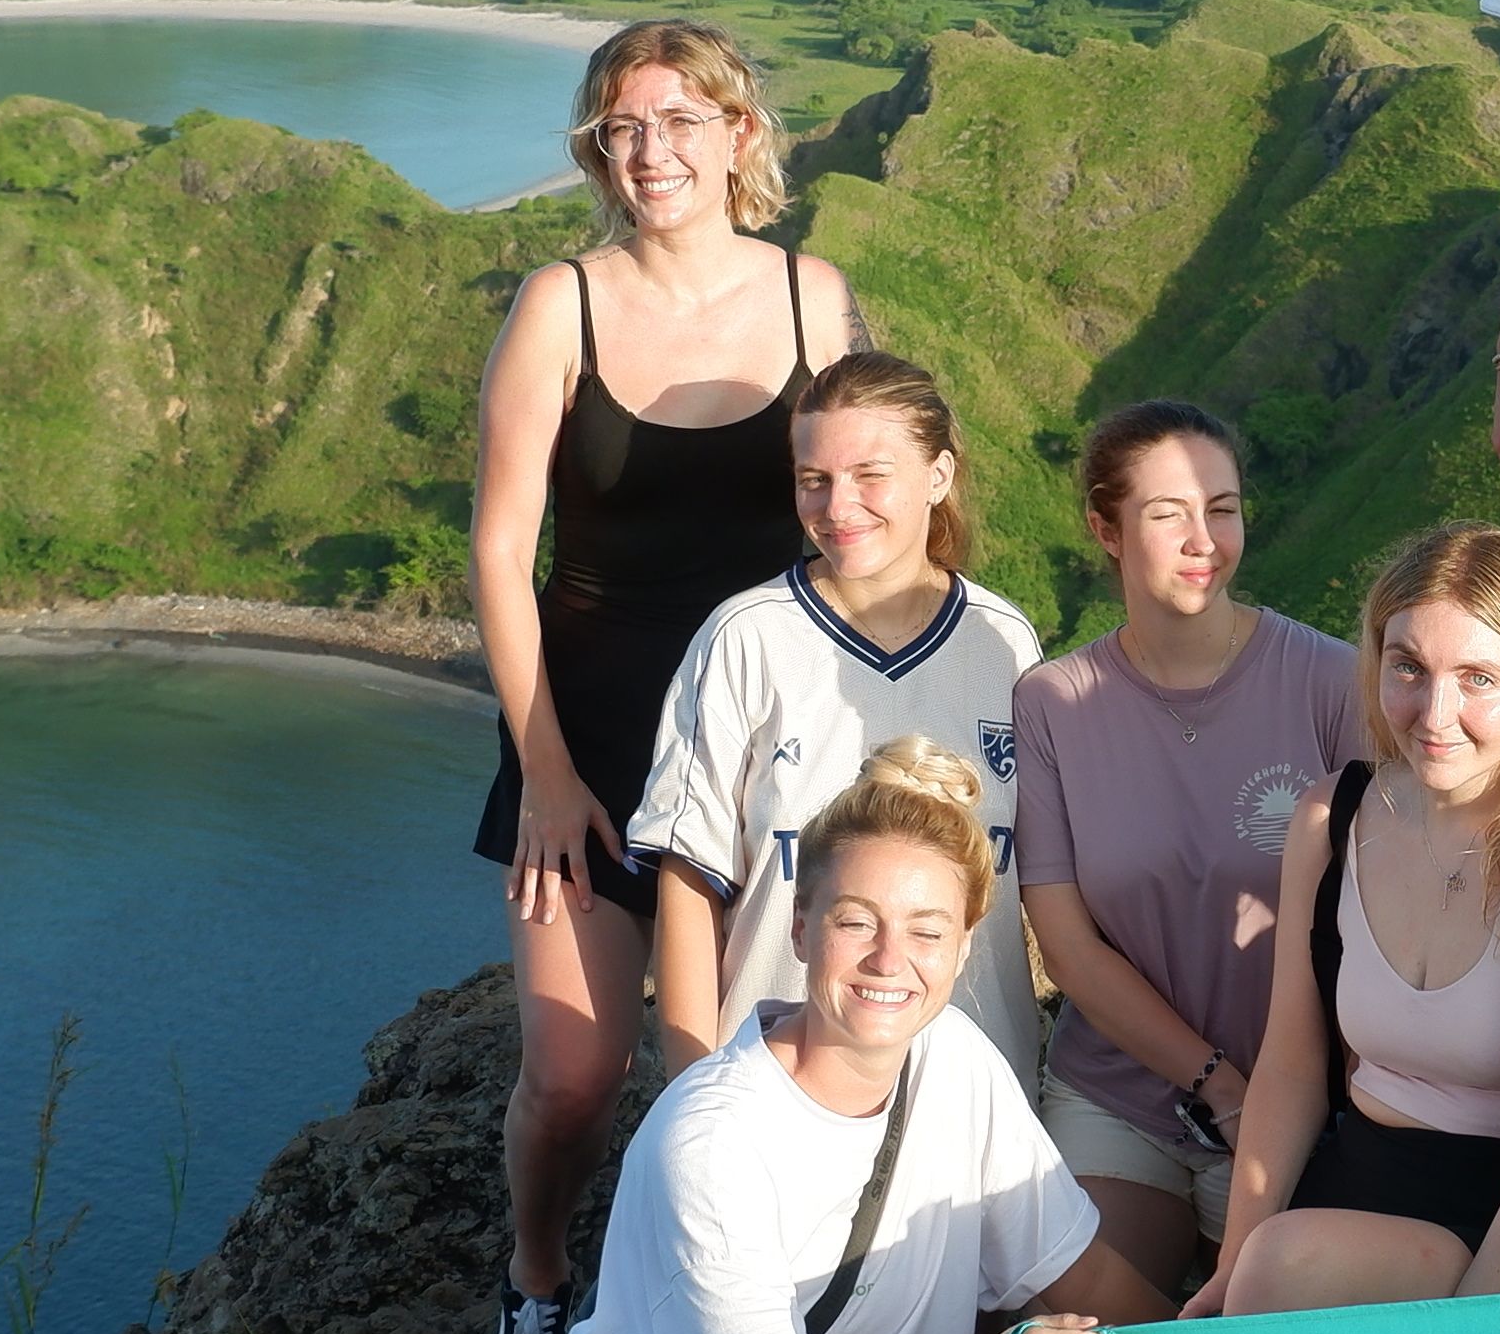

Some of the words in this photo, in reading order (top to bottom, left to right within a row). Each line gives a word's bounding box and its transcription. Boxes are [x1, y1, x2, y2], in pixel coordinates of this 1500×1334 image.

[1233, 763, 1291, 806] SISTERHOOD
[1296, 769, 1317, 788] SUR
[1233, 814, 1250, 839] BALI
